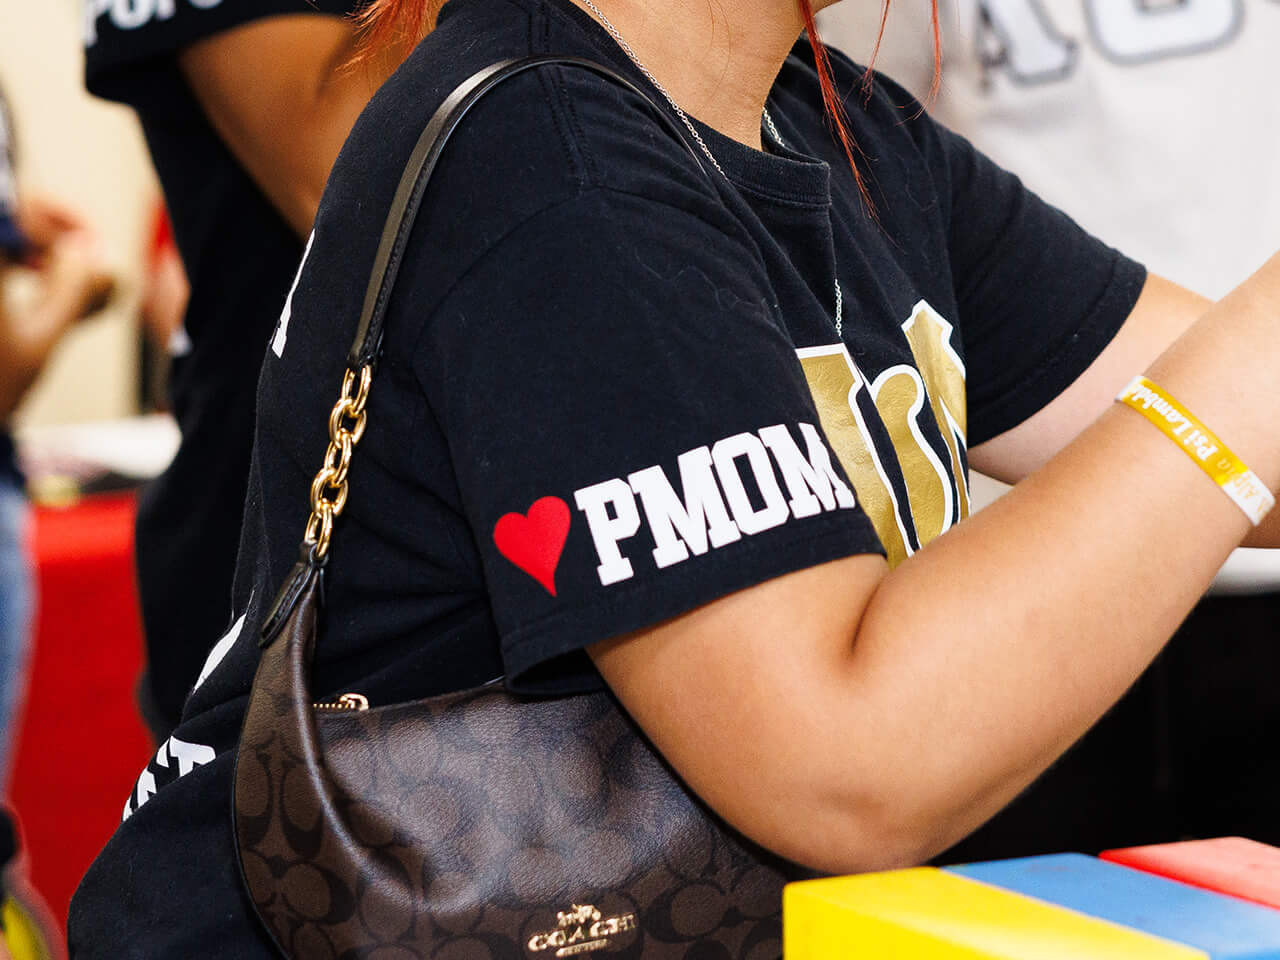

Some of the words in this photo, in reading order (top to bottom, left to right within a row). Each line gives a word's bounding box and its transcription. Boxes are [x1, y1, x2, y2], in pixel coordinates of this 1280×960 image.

[1184, 430, 1218, 461] Psi
[574, 422, 856, 586] PMOM
[528, 914, 637, 951] COACH
